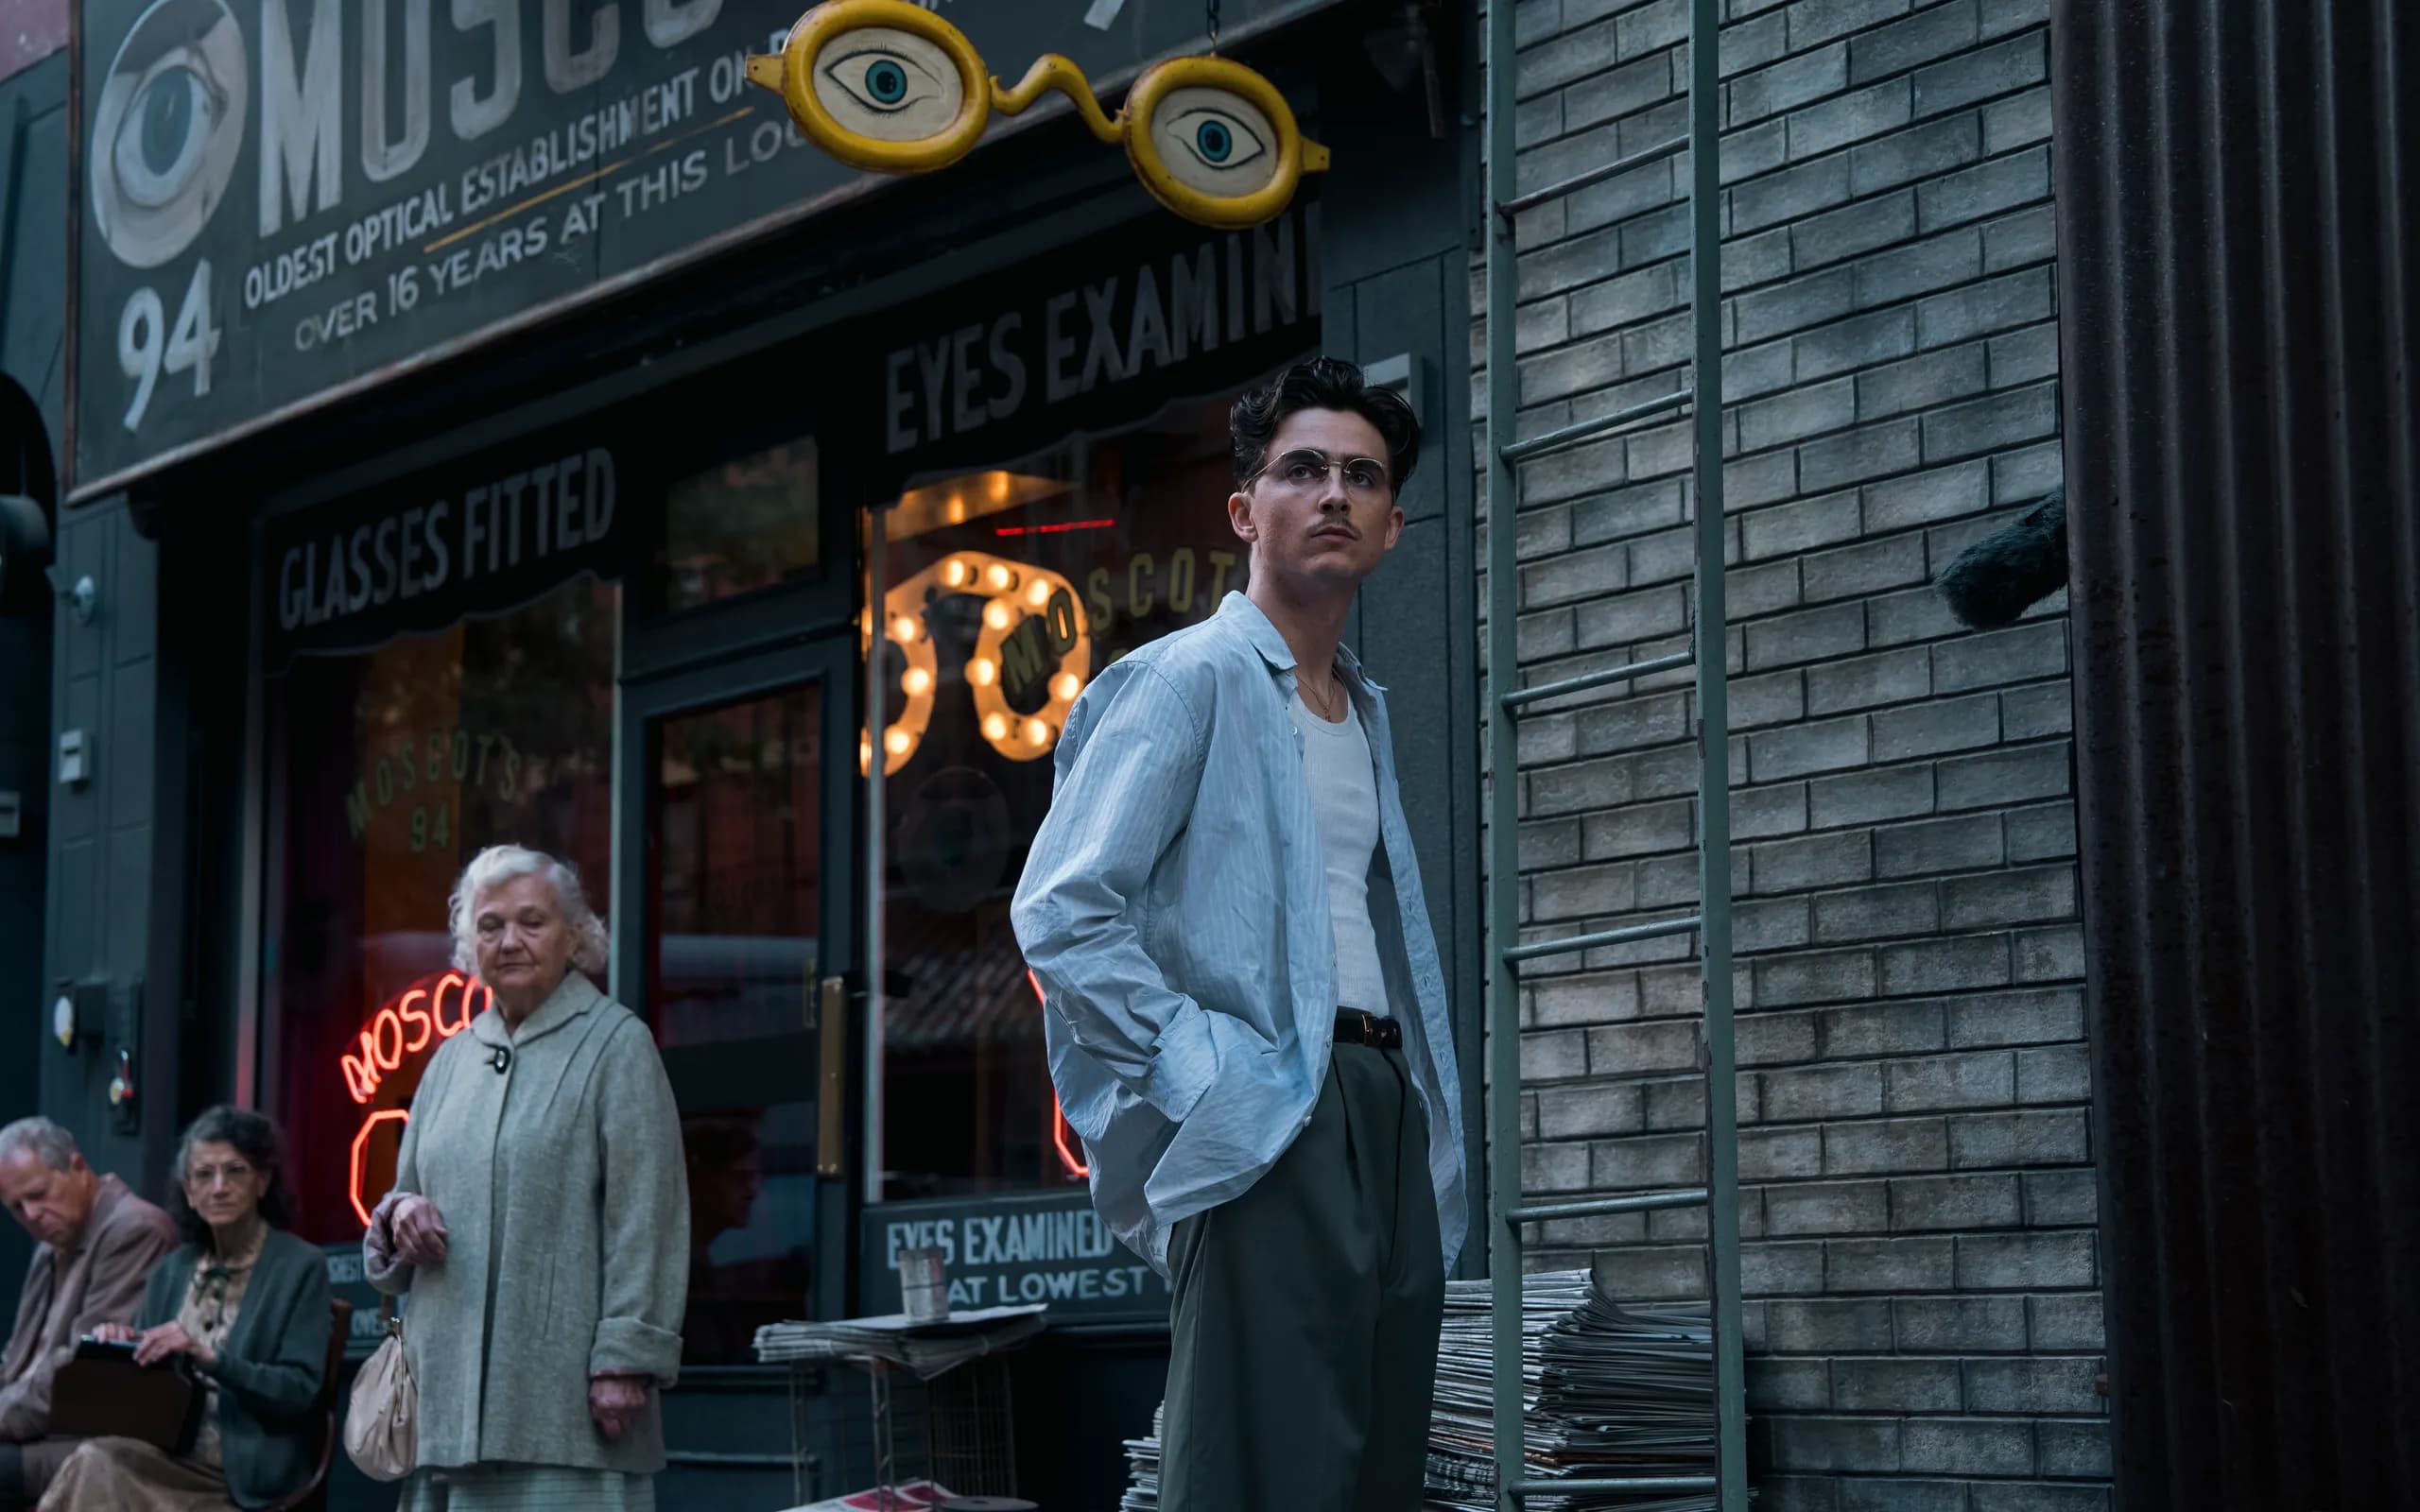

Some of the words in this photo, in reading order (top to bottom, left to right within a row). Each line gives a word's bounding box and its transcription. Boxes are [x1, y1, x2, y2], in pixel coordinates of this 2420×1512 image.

[245, 232, 338, 310] OLDEST
[345, 182, 455, 266] OPTICAL
[461, 66, 700, 216] ESTABLISHMENT
[259, 0, 723, 239] MOS
[295, 290, 378, 352] OVER
[389, 266, 420, 317] 16
[429, 216, 548, 295] YEARS
[561, 192, 607, 245] AT
[616, 150, 708, 218] THIS
[119, 257, 222, 433] 94
[886, 311, 1028, 454] EYES
[279, 499, 450, 631] GLASSES
[462, 446, 616, 580] FITTED
[410, 801, 451, 853] 94
[887, 1219, 955, 1269] EYES
[963, 1210, 1115, 1265] EXAMINED
[948, 1277, 989, 1304] AT
[998, 1265, 1150, 1303] LOWEST
